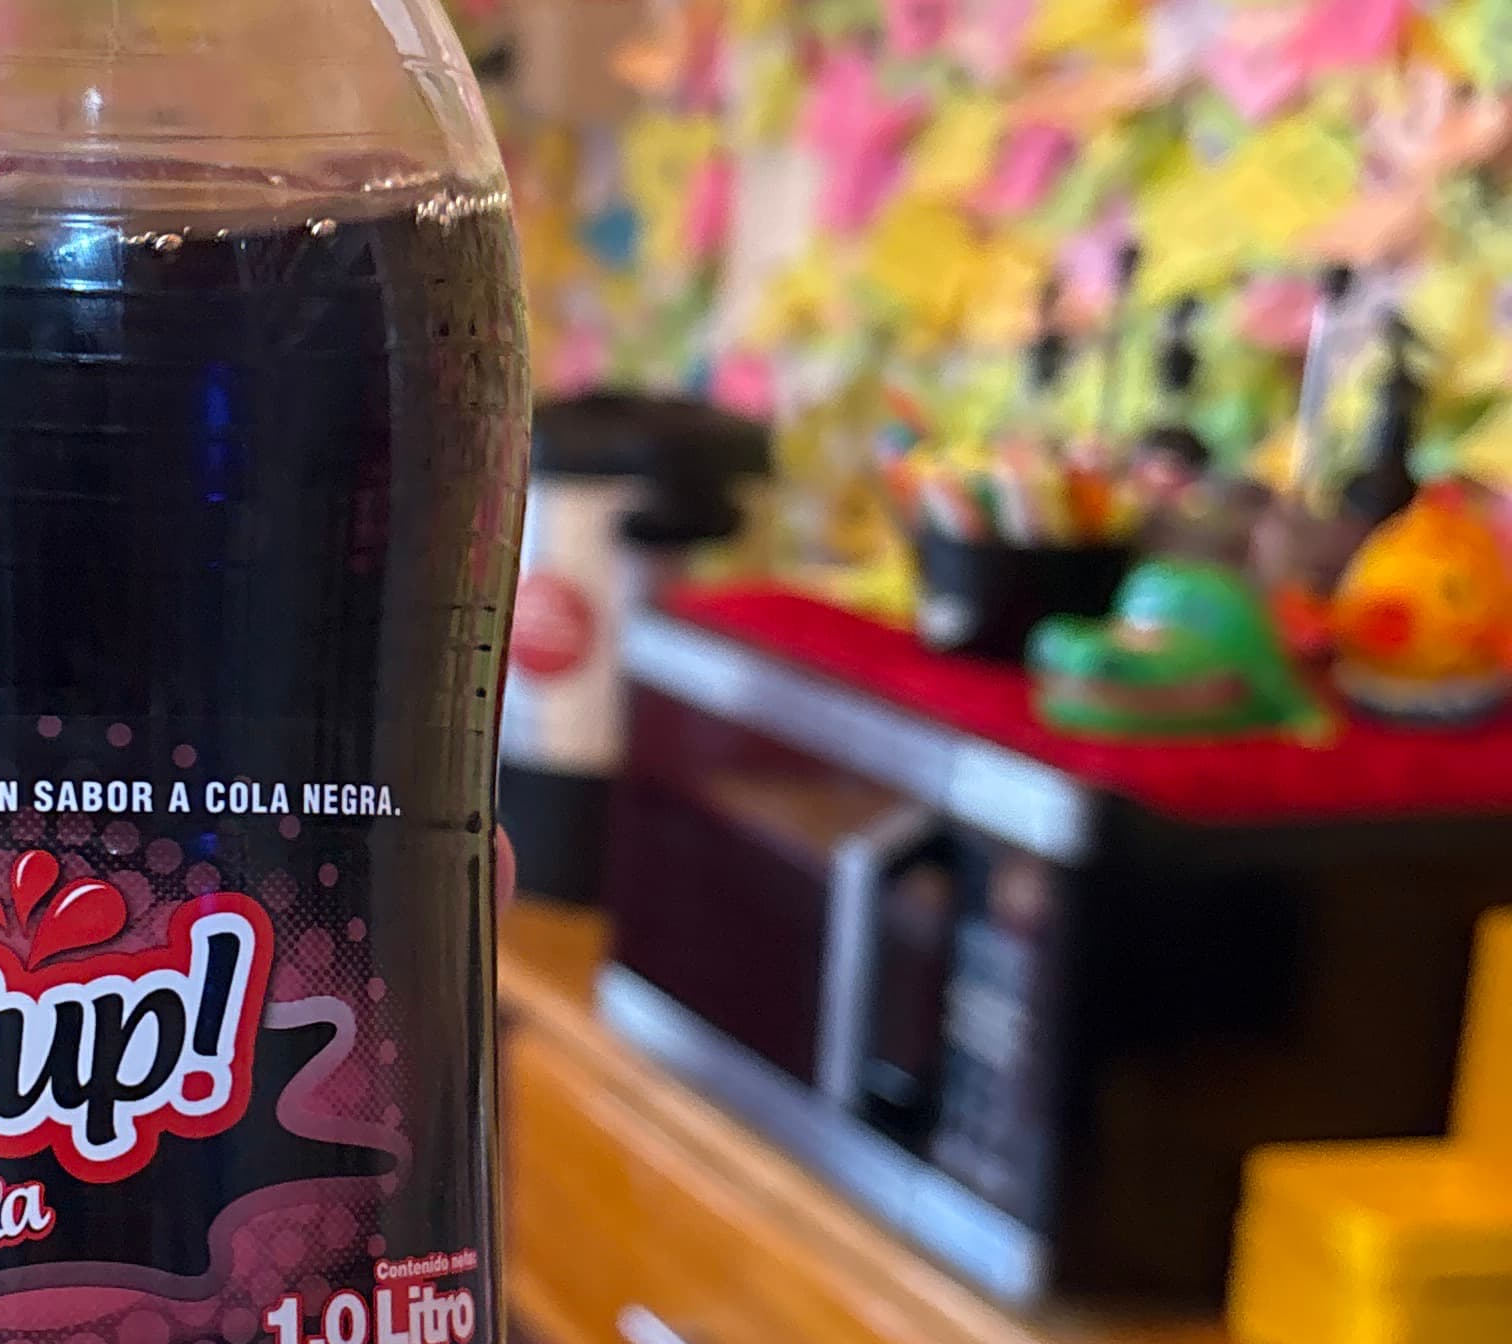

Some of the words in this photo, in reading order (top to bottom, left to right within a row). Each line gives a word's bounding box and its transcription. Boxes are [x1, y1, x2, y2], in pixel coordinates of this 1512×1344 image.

[33, 780, 154, 813] SABOR
[168, 781, 191, 813] A
[205, 781, 290, 813] COLA
[303, 783, 401, 816] NEGRA.
[376, 1256, 448, 1280] Contenido
